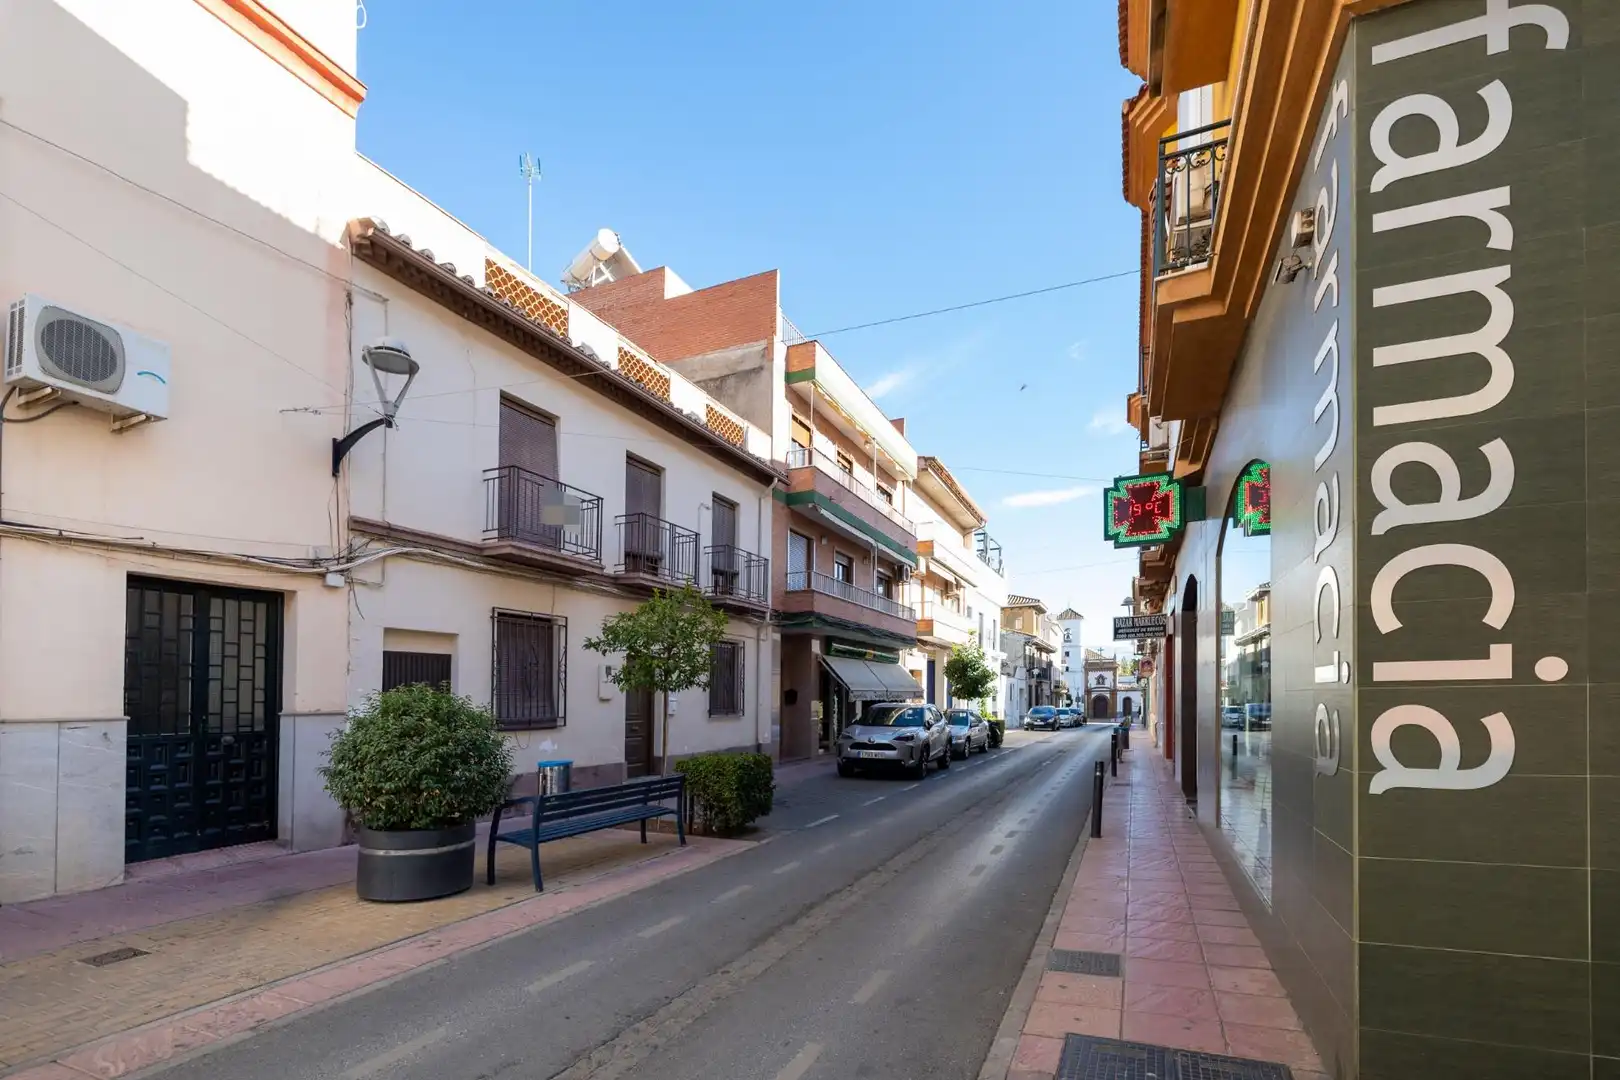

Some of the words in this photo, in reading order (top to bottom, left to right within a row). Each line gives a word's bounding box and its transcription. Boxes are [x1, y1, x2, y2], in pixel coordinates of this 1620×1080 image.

[1115, 617, 1133, 628] BAZAR
[1312, 78, 1350, 778] farmacia
[1369, 0, 1570, 795] farmacia
